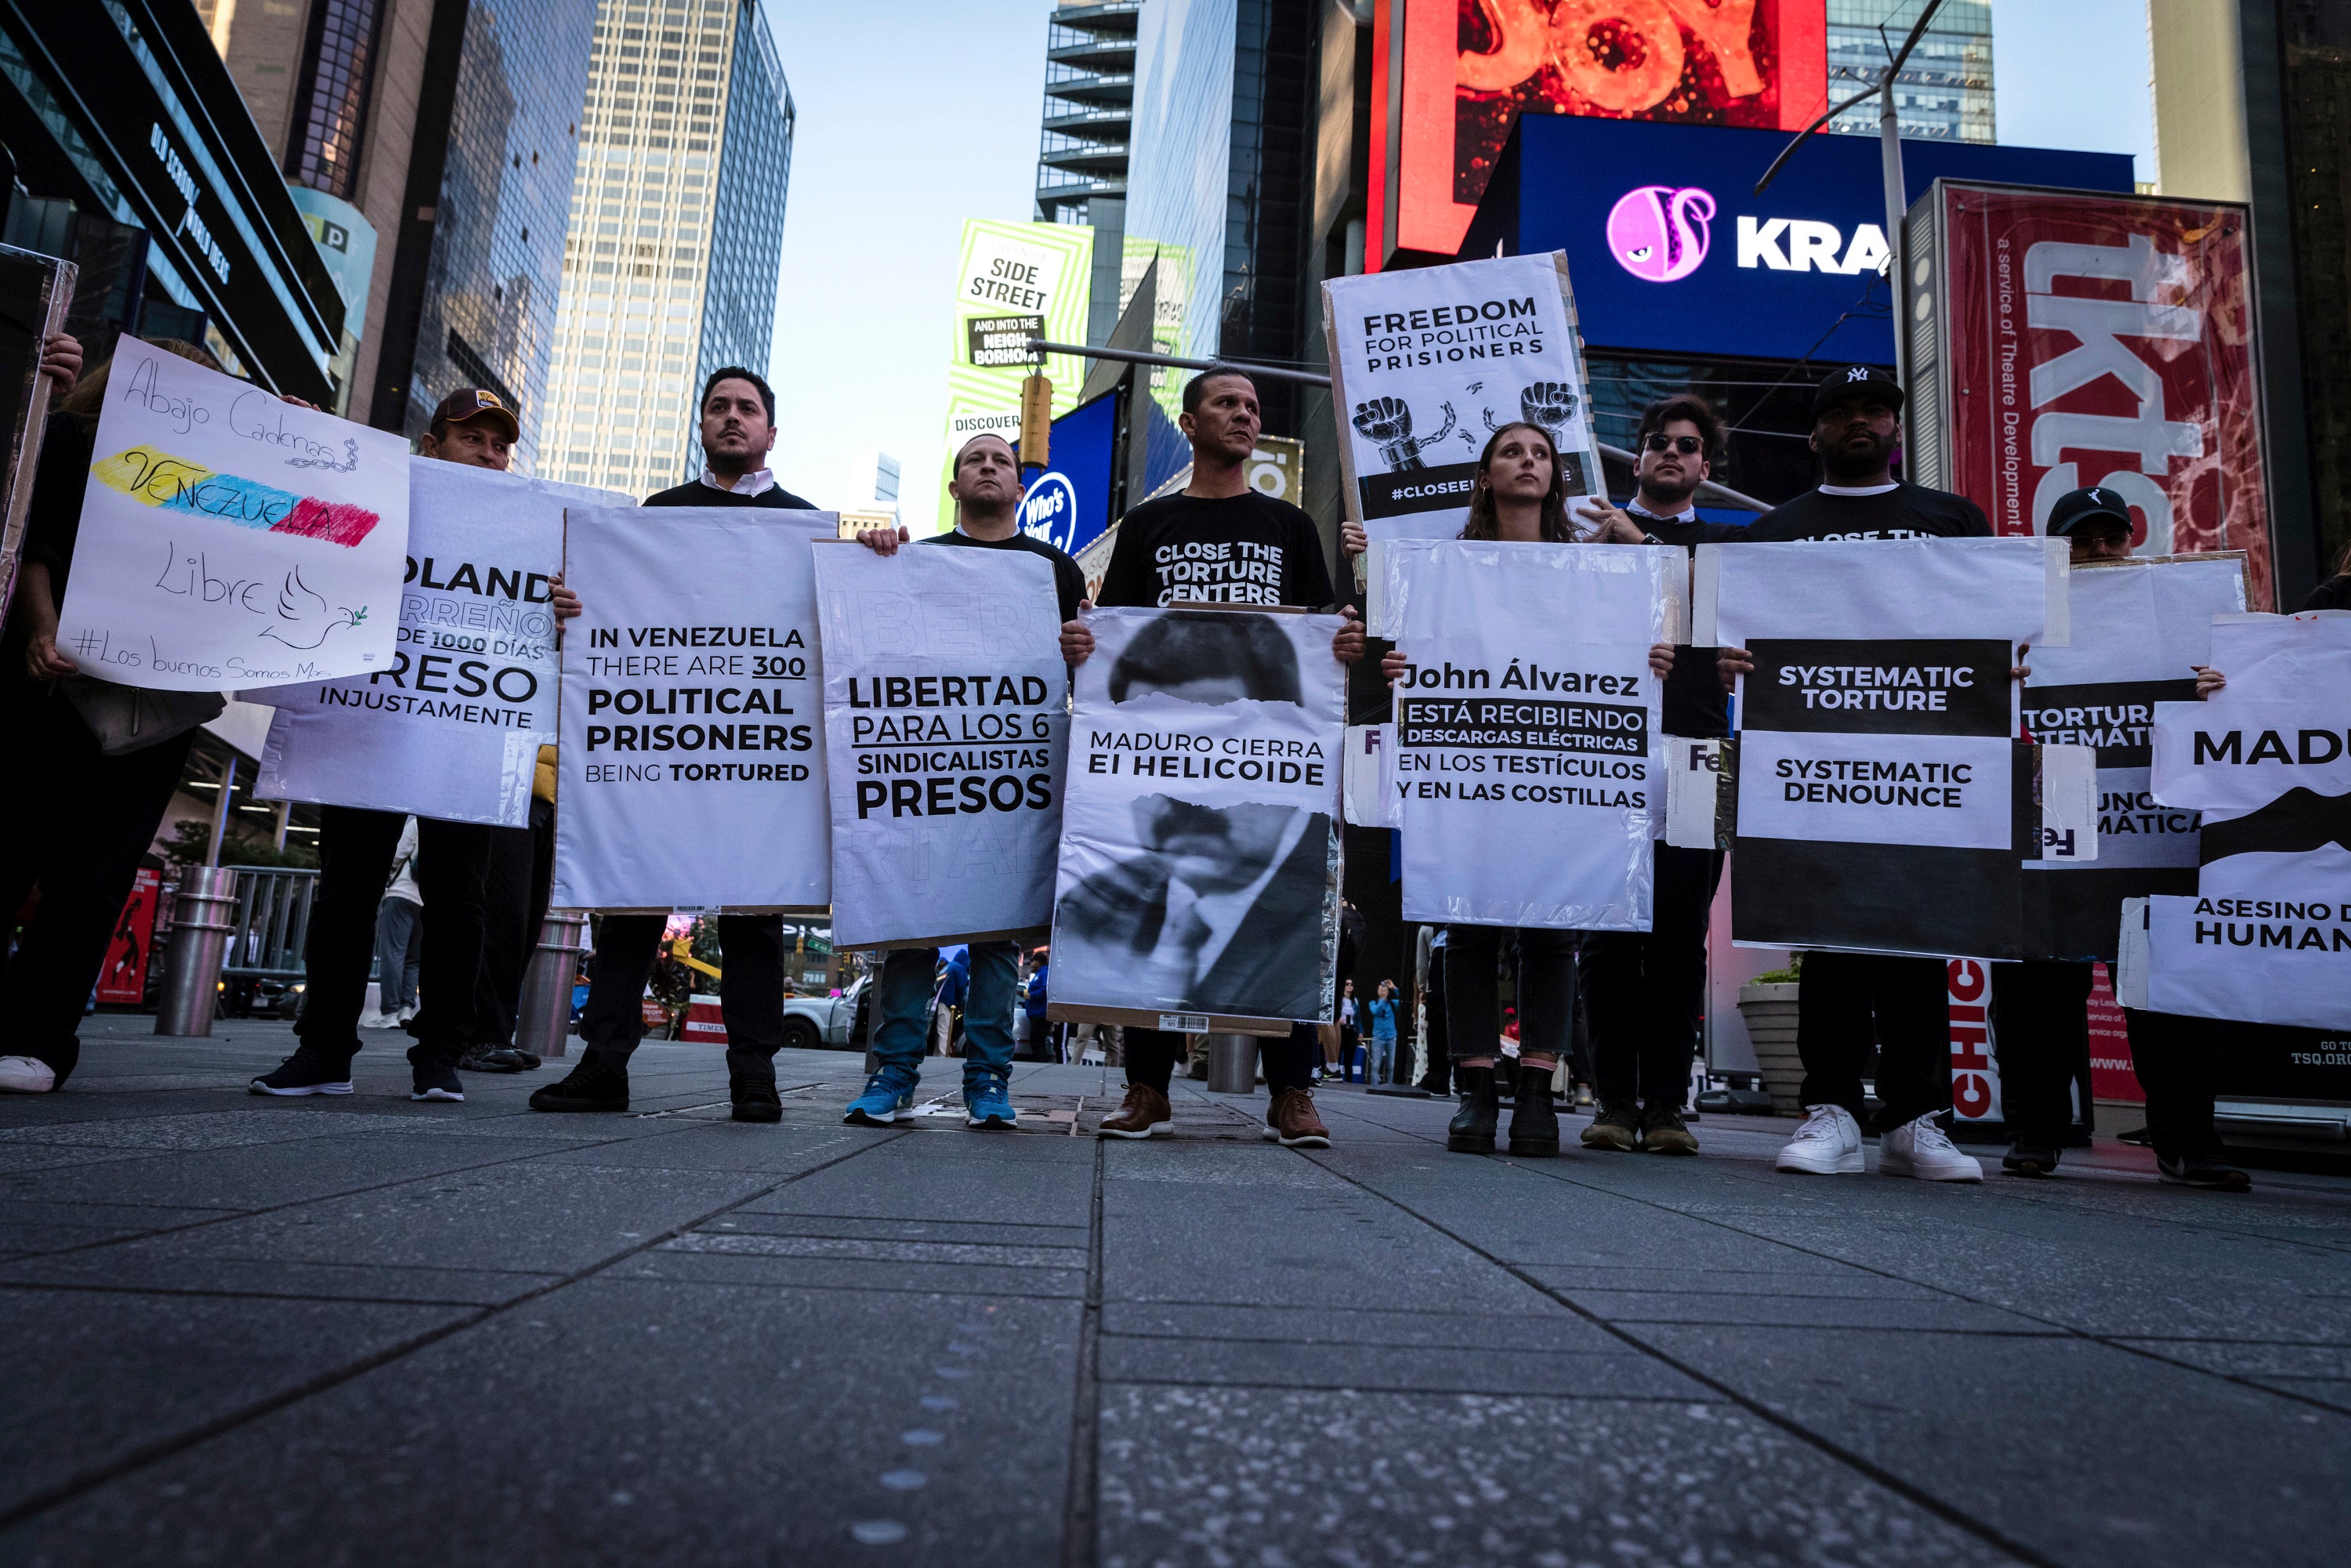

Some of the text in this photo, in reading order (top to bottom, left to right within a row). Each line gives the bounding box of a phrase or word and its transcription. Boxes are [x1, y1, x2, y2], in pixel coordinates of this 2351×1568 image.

[1737, 215, 1891, 277] KRA
[1998, 238, 2009, 250] a
[991, 258, 1039, 285] SIDE
[1998, 252, 2012, 316] service
[971, 277, 1046, 310] STREET
[975, 317, 1038, 332] AND INTO THE
[1363, 297, 1537, 337] FREEDOM
[1999, 318, 2013, 338] of
[984, 332, 1031, 349] NEIGH-
[1365, 320, 1544, 355] FOR POLITICAL
[1367, 339, 1544, 373] PRISIONERS
[1846, 368, 1868, 382] NY
[2001, 340, 2017, 406] Theatre
[124, 357, 335, 462] Abajo Cadenas
[955, 415, 1020, 432] DISCOVER
[2001, 411, 2023, 526] Development
[125, 451, 332, 536] VENEZUELA
[1027, 487, 1064, 526] Who's
[1155, 541, 1283, 566] CLOSE THE
[155, 541, 266, 614] Libre
[1156, 560, 1283, 587] TORTURE
[1157, 581, 1281, 608] CENTERS
[432, 632, 487, 653] 1000
[493, 639, 545, 660] DÍAS
[590, 627, 806, 649] IN VENEZUELA
[70, 629, 141, 666] #Los
[150, 636, 222, 679] buenos
[226, 657, 291, 679] Somos
[586, 655, 806, 679] THERE ARE 300
[1399, 657, 1639, 697] John Álvarez
[1778, 666, 1974, 688] SYSTEMATIC
[589, 687, 794, 715] POLITICAL
[849, 675, 1048, 708] LIBERTAD
[1802, 689, 1947, 712] TORTURE
[320, 686, 533, 730] INJUSTAMENTE
[1407, 700, 1643, 732] ESTÁ RECIBIENDO
[2022, 704, 2154, 729] TORTUR
[587, 724, 813, 751] PRISONERS
[853, 712, 1049, 743] PARA LOS 6
[1407, 729, 1638, 751] DESCARGAS ELÉCTRICAS
[1090, 730, 1324, 759] MADURO CIERRA
[2194, 729, 2351, 765] MAD
[586, 763, 810, 782] BEING TORTURED
[857, 749, 1049, 775] SINDICALISTAS
[1133, 755, 1324, 786] HELICOIDE
[1399, 753, 1646, 780] EN LOS TESTÍCULOS
[1775, 759, 1972, 784] SYSTEMATIC
[857, 773, 1052, 820] PRESOS
[1396, 781, 1646, 809] Y EN LAS COSTILLAS
[1784, 782, 1962, 808] DENOUNCE
[2194, 897, 2331, 921] ASESINO
[1947, 959, 1991, 1118] CHIC
[2320, 1041, 2336, 1050] GO
[2090, 1058, 2133, 1071] www.
